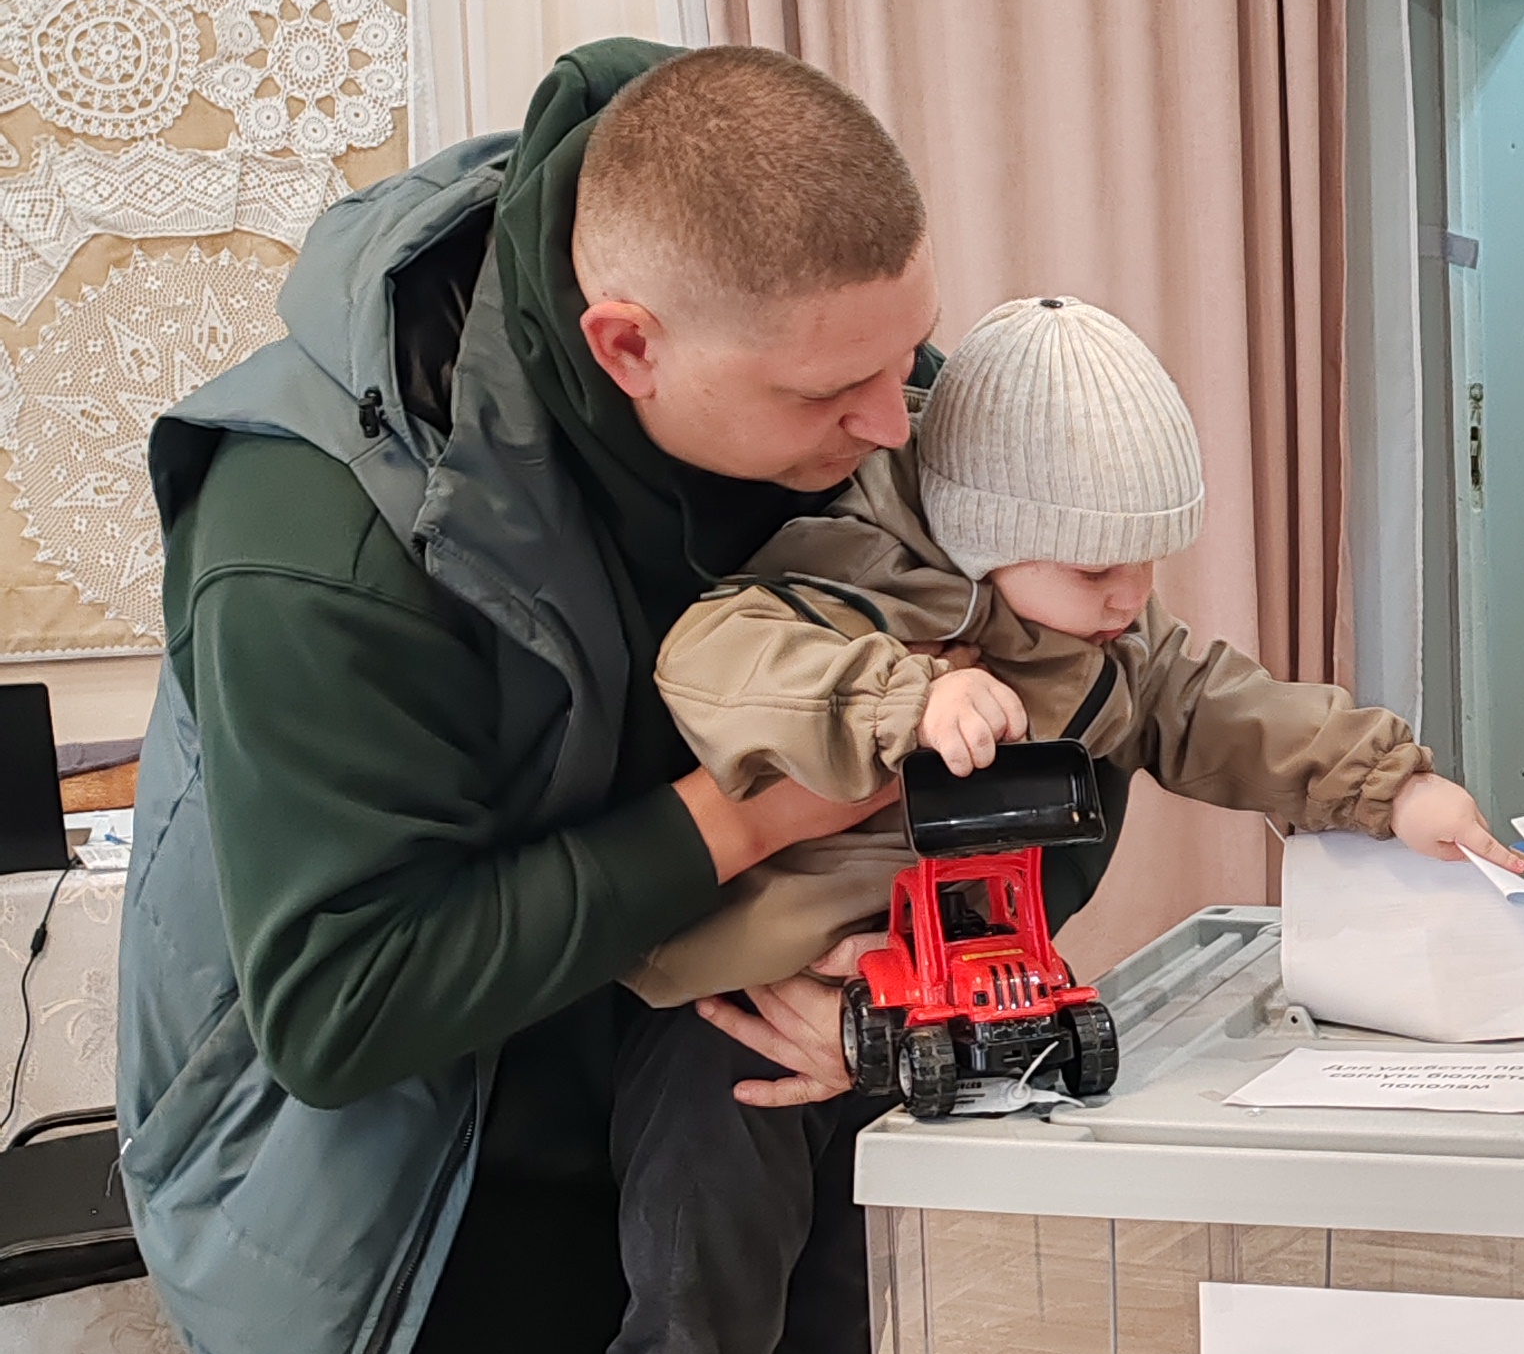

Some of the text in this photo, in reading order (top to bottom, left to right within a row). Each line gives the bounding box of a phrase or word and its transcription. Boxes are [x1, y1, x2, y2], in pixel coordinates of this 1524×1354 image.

[1322, 1063, 1373, 1071] Для
[1379, 1064, 1487, 1072] удобства
[1329, 1072, 1420, 1080] согнуть
[1379, 1082, 1490, 1090] пополам
